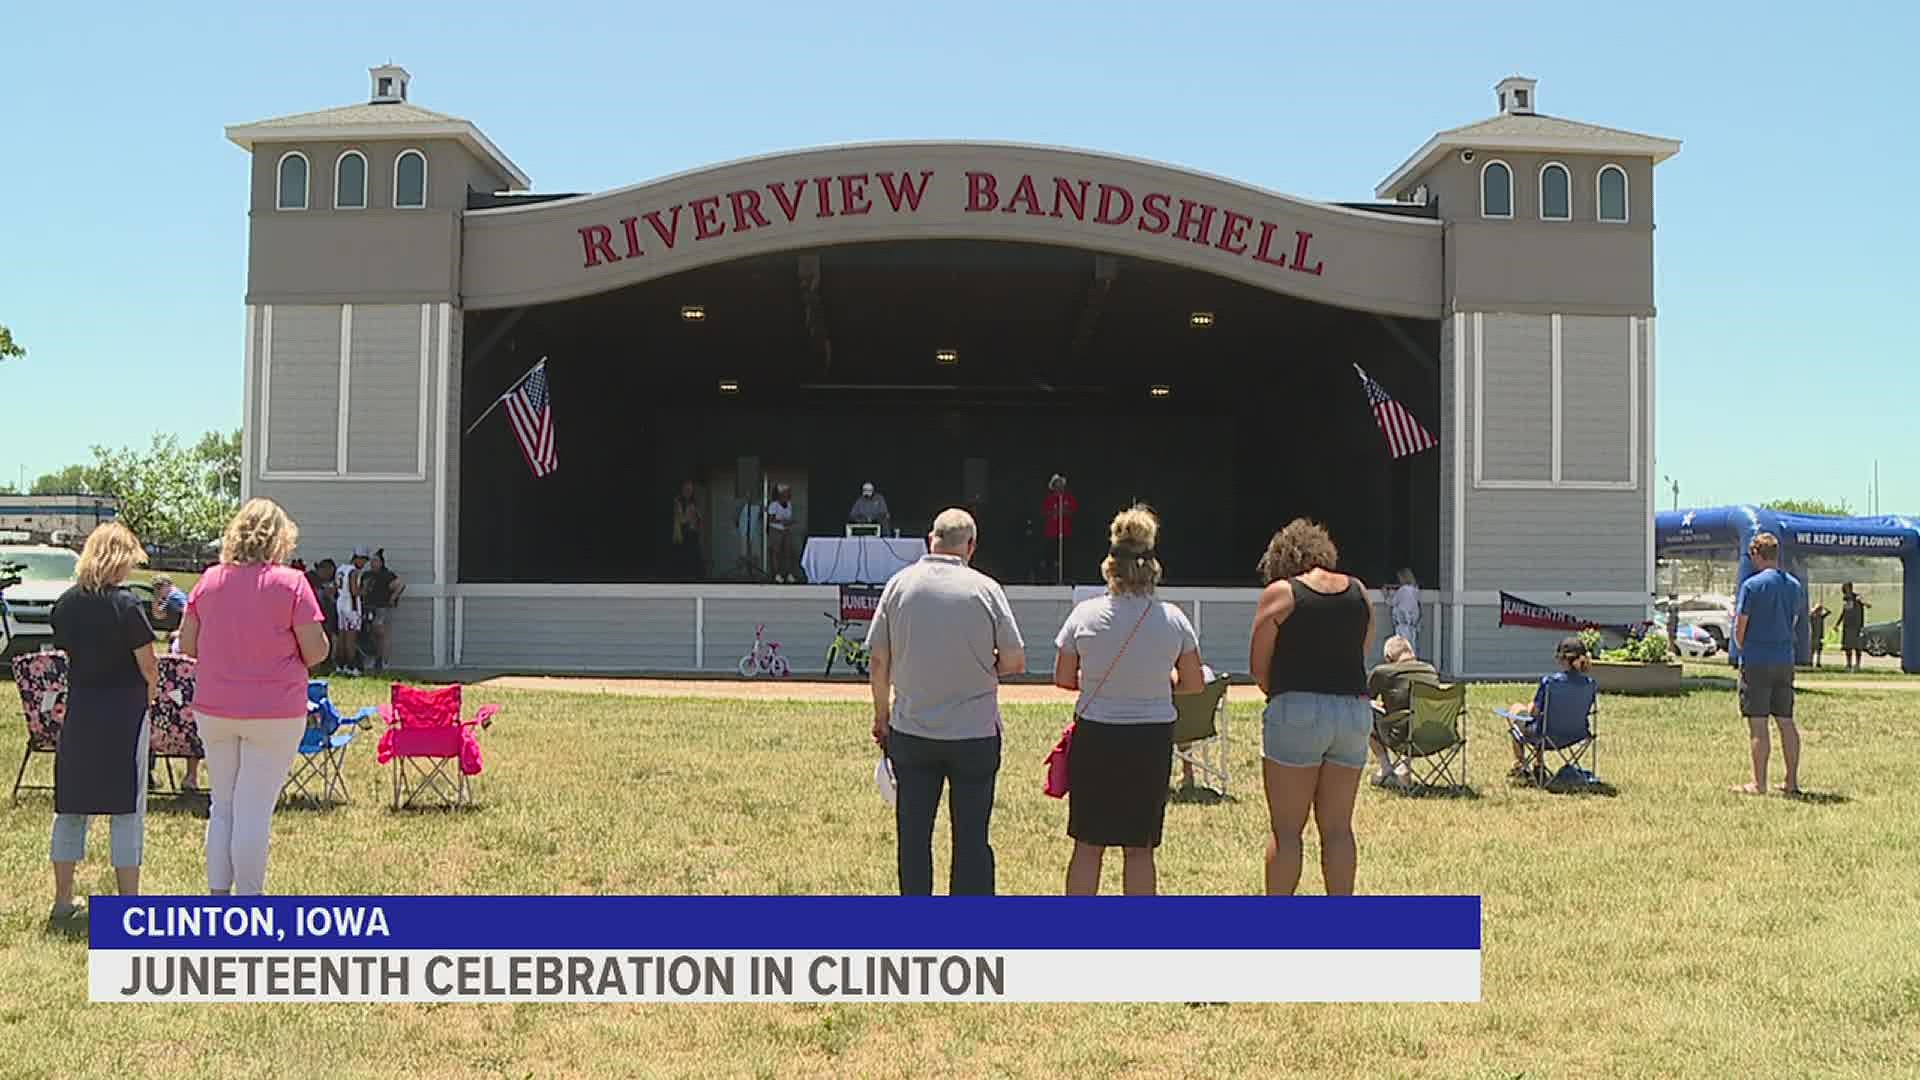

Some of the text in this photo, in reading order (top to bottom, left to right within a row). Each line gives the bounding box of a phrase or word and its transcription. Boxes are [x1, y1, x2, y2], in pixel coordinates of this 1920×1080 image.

[579, 172, 1325, 276] RIVERVIEW BANDSHELL
[1797, 532, 1812, 545] WE
[1813, 533, 1837, 546] KEEP
[1839, 535, 1859, 547] LIFE
